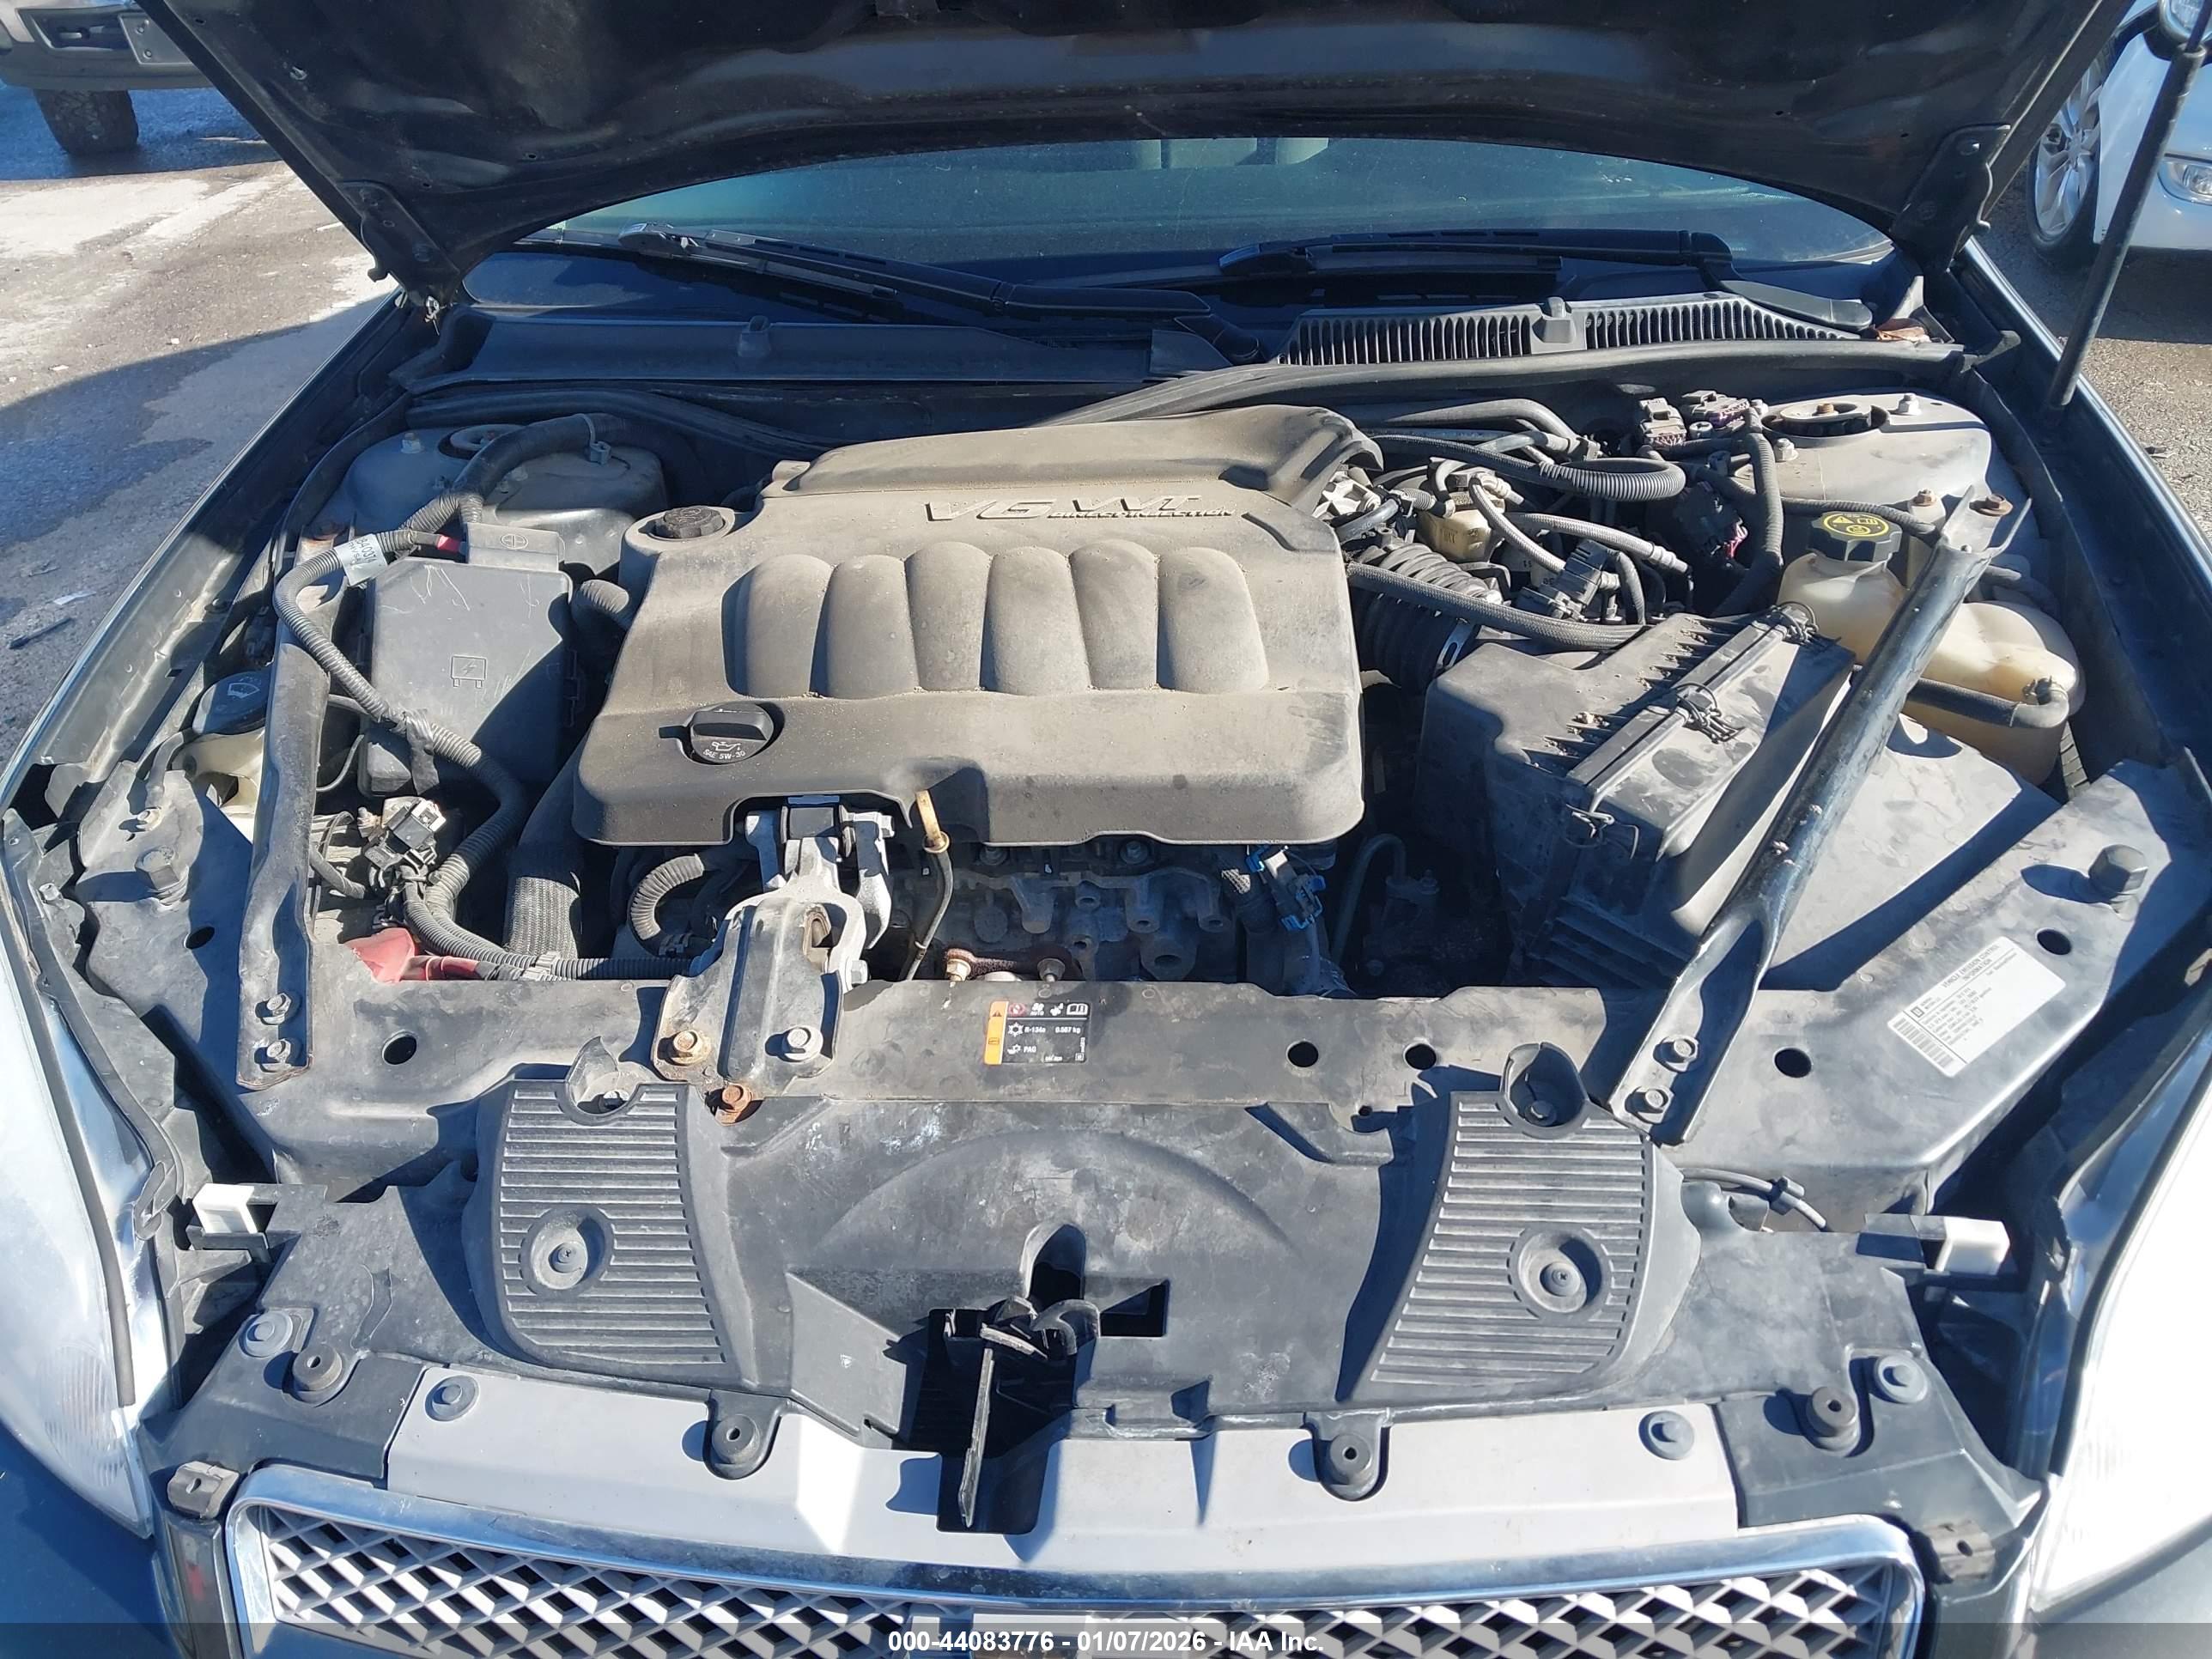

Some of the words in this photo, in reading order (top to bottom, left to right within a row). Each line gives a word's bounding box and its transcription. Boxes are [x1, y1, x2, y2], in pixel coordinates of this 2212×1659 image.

[925, 499, 1056, 521] V6
[1071, 495, 1201, 512] VVT
[703, 749, 717, 758] SAE
[719, 750, 746, 760] 5W-30
